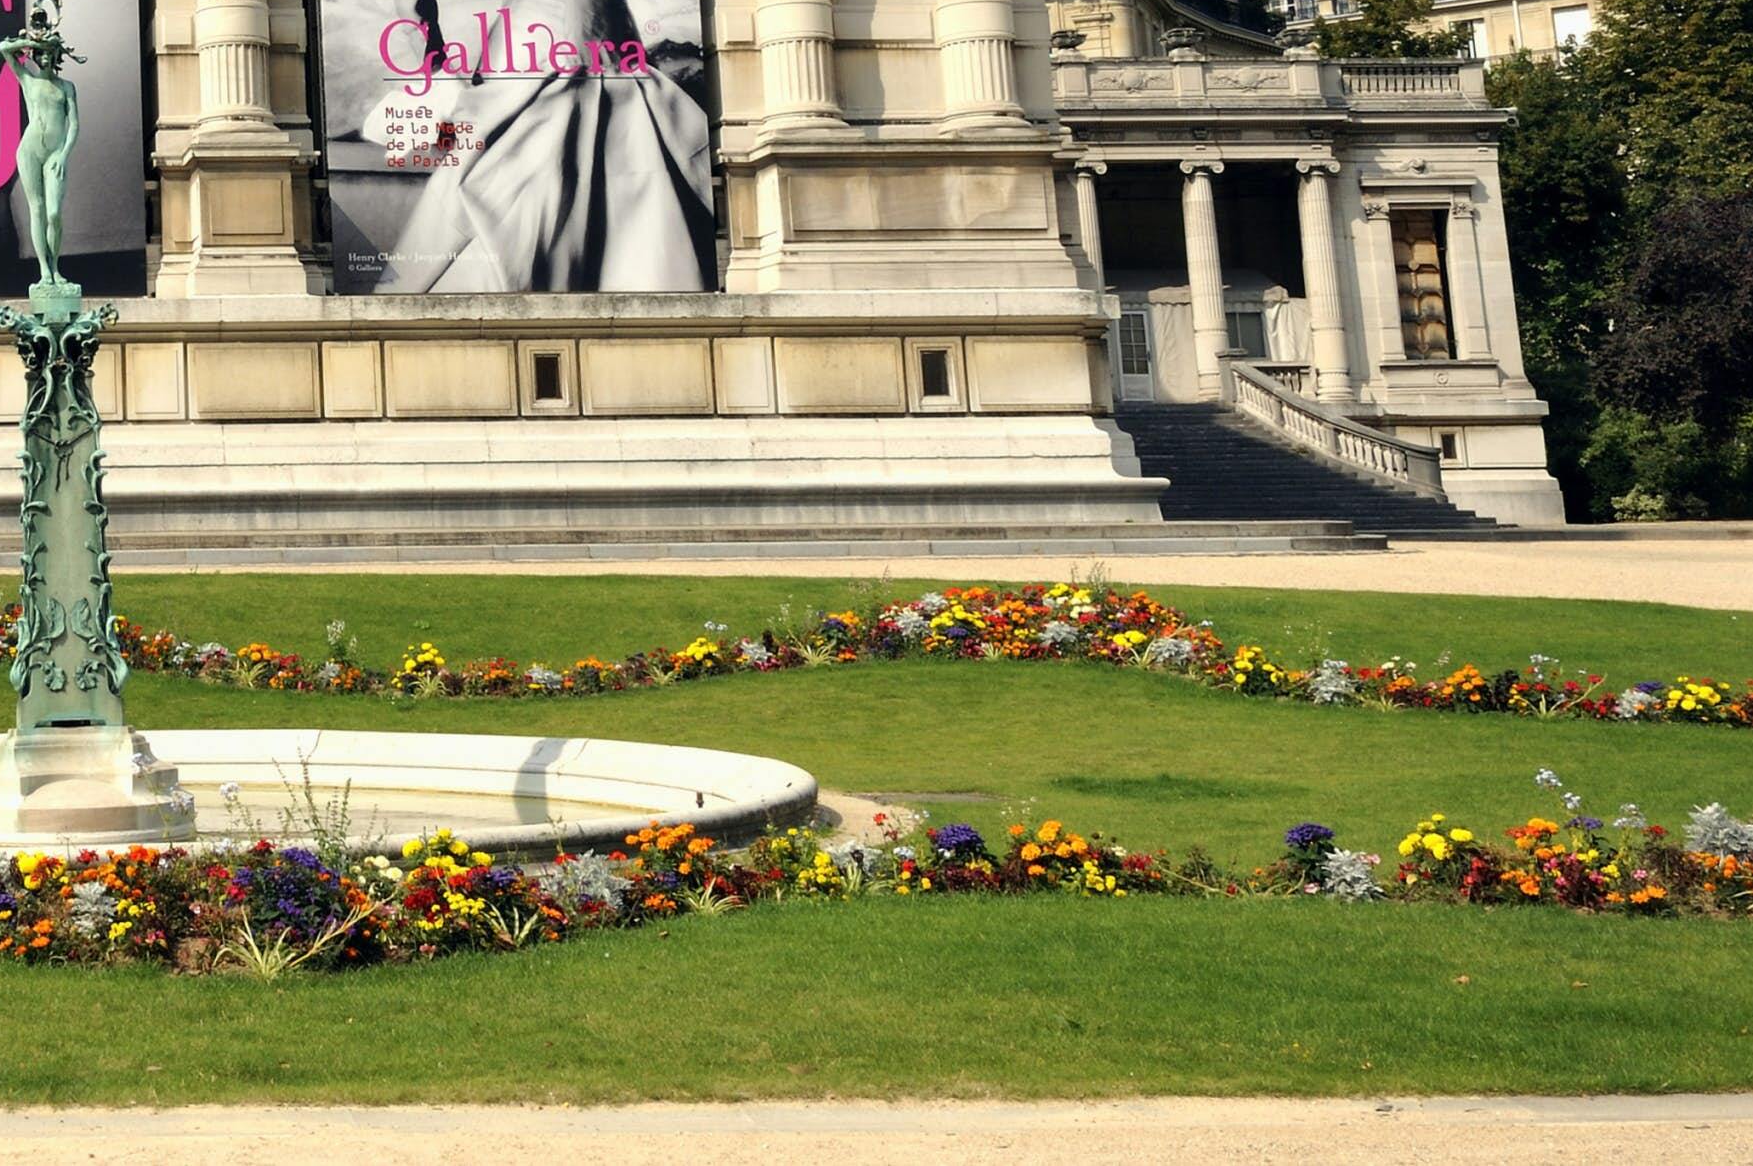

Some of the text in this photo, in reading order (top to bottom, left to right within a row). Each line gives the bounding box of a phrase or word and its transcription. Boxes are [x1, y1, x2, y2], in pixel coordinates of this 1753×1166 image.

[378, 8, 652, 97] Galliera
[385, 105, 434, 119] Musée
[386, 120, 474, 135] de la Mode
[386, 138, 405, 151] de
[412, 138, 429, 151] la
[387, 153, 461, 168] de Paris
[348, 252, 376, 263] Henry
[356, 263, 383, 272] Galliera
